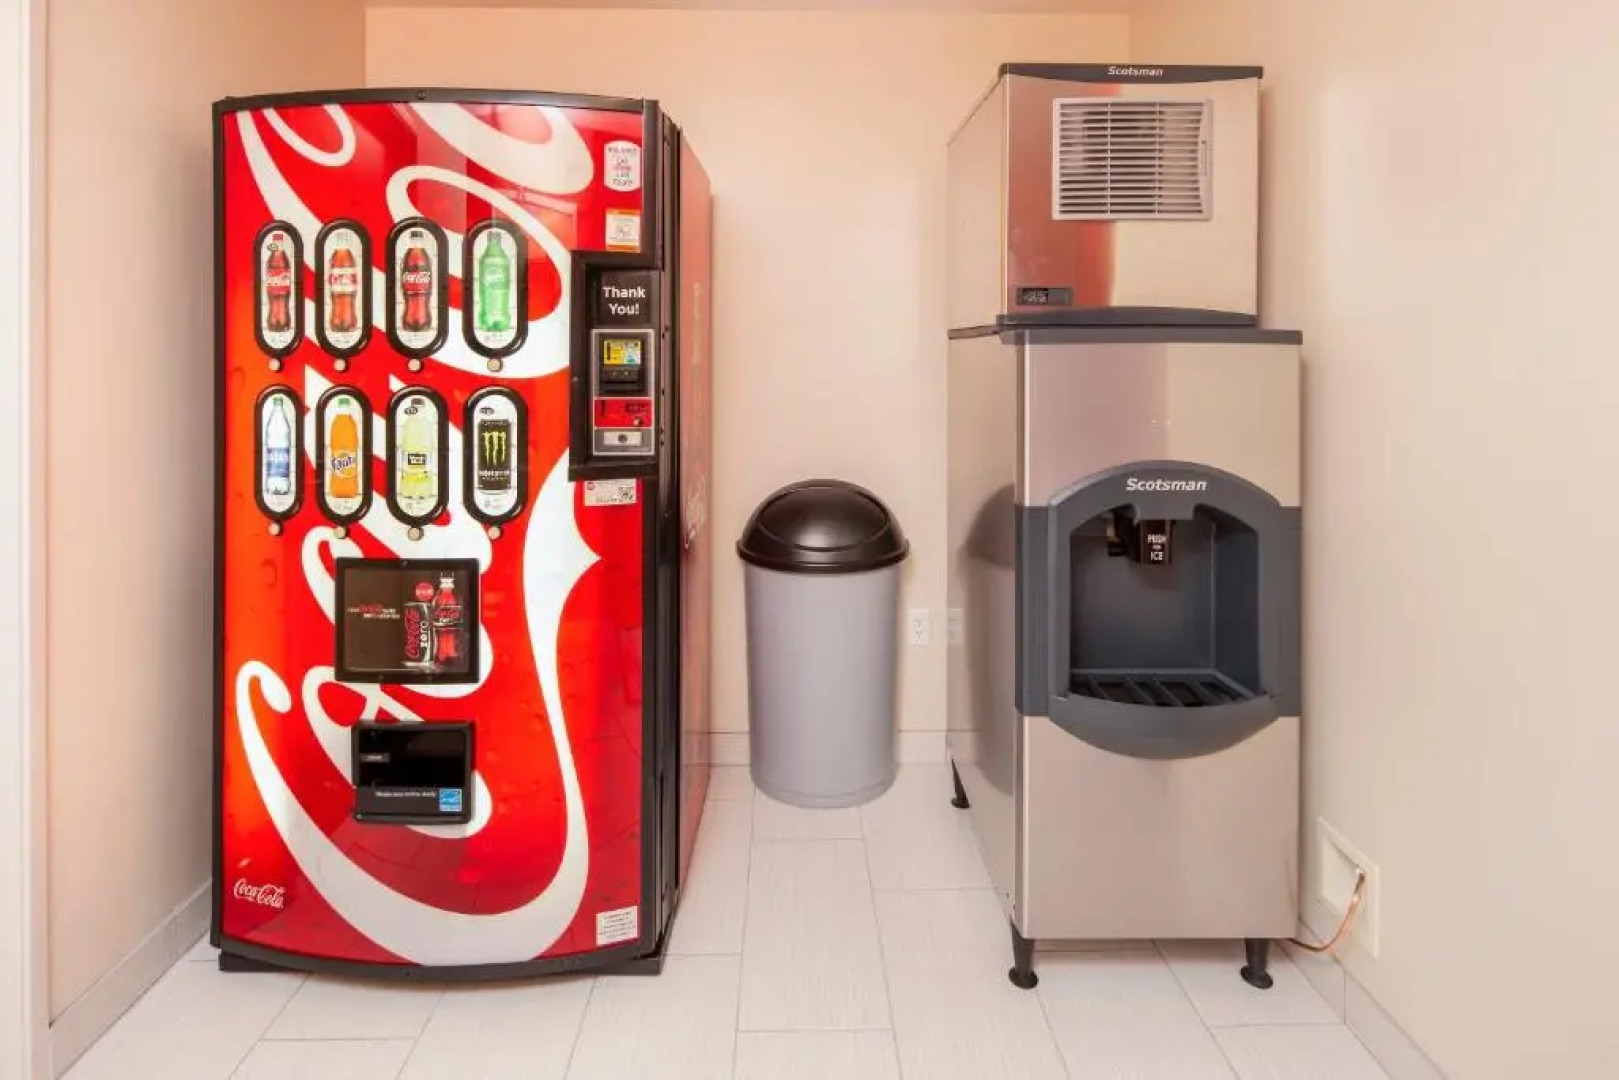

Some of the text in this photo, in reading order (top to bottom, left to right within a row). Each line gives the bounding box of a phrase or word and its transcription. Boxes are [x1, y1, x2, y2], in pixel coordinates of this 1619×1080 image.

[1107, 66, 1163, 77] Scotsman
[602, 286, 646, 298] Thank
[609, 303, 640, 315] You!
[1126, 478, 1207, 491] Scotsman
[1147, 534, 1167, 543] PUSH
[1150, 552, 1163, 561] ICE
[420, 620, 429, 648] zero
